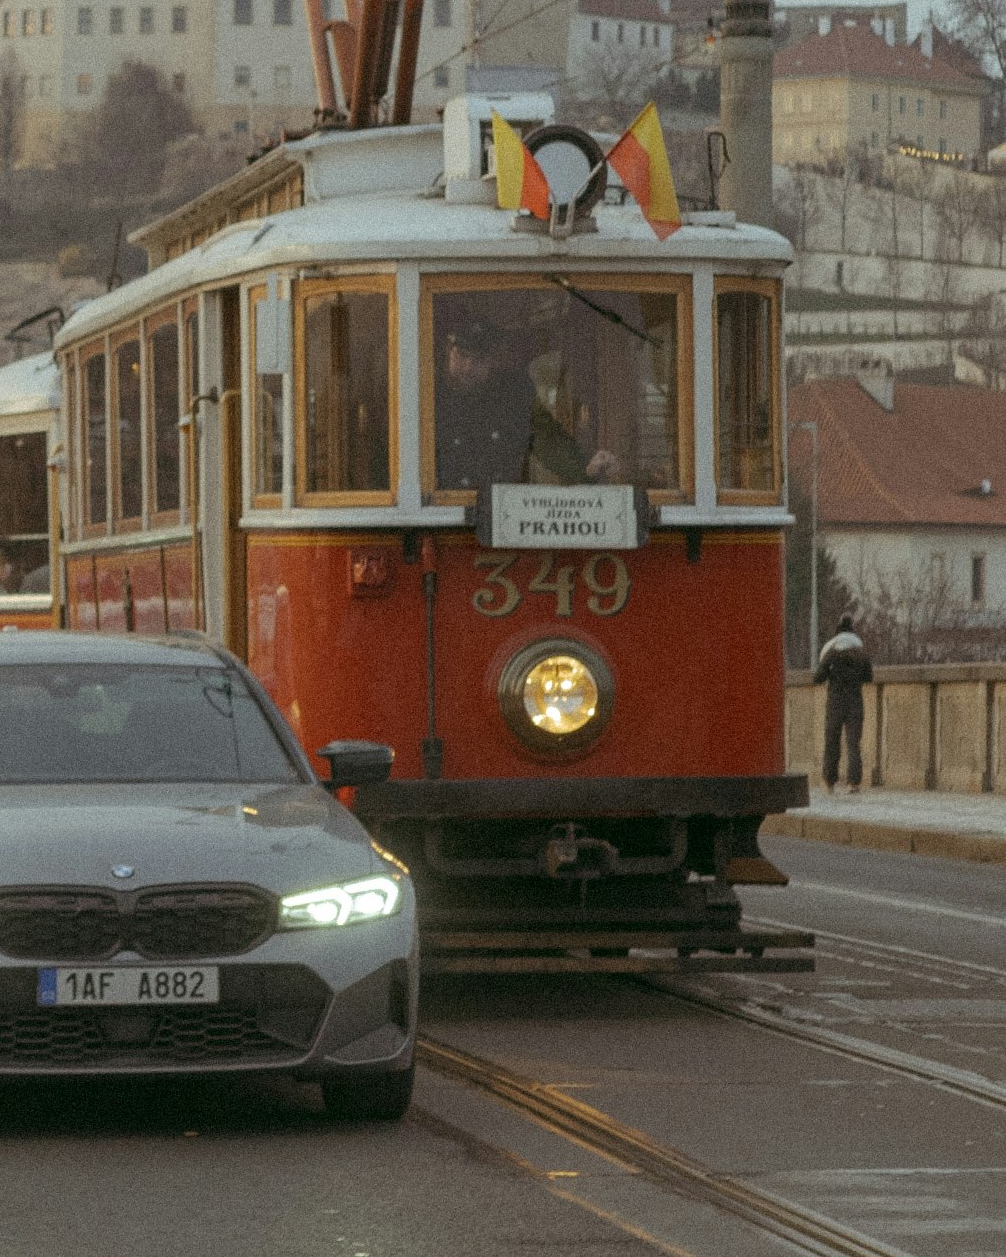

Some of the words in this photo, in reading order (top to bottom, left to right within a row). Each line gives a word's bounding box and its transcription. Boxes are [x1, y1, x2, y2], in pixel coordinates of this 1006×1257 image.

[519, 521, 607, 536] PRAHOU
[472, 551, 632, 618] 349
[65, 971, 115, 1001] 1AF
[137, 970, 206, 1000] A882
